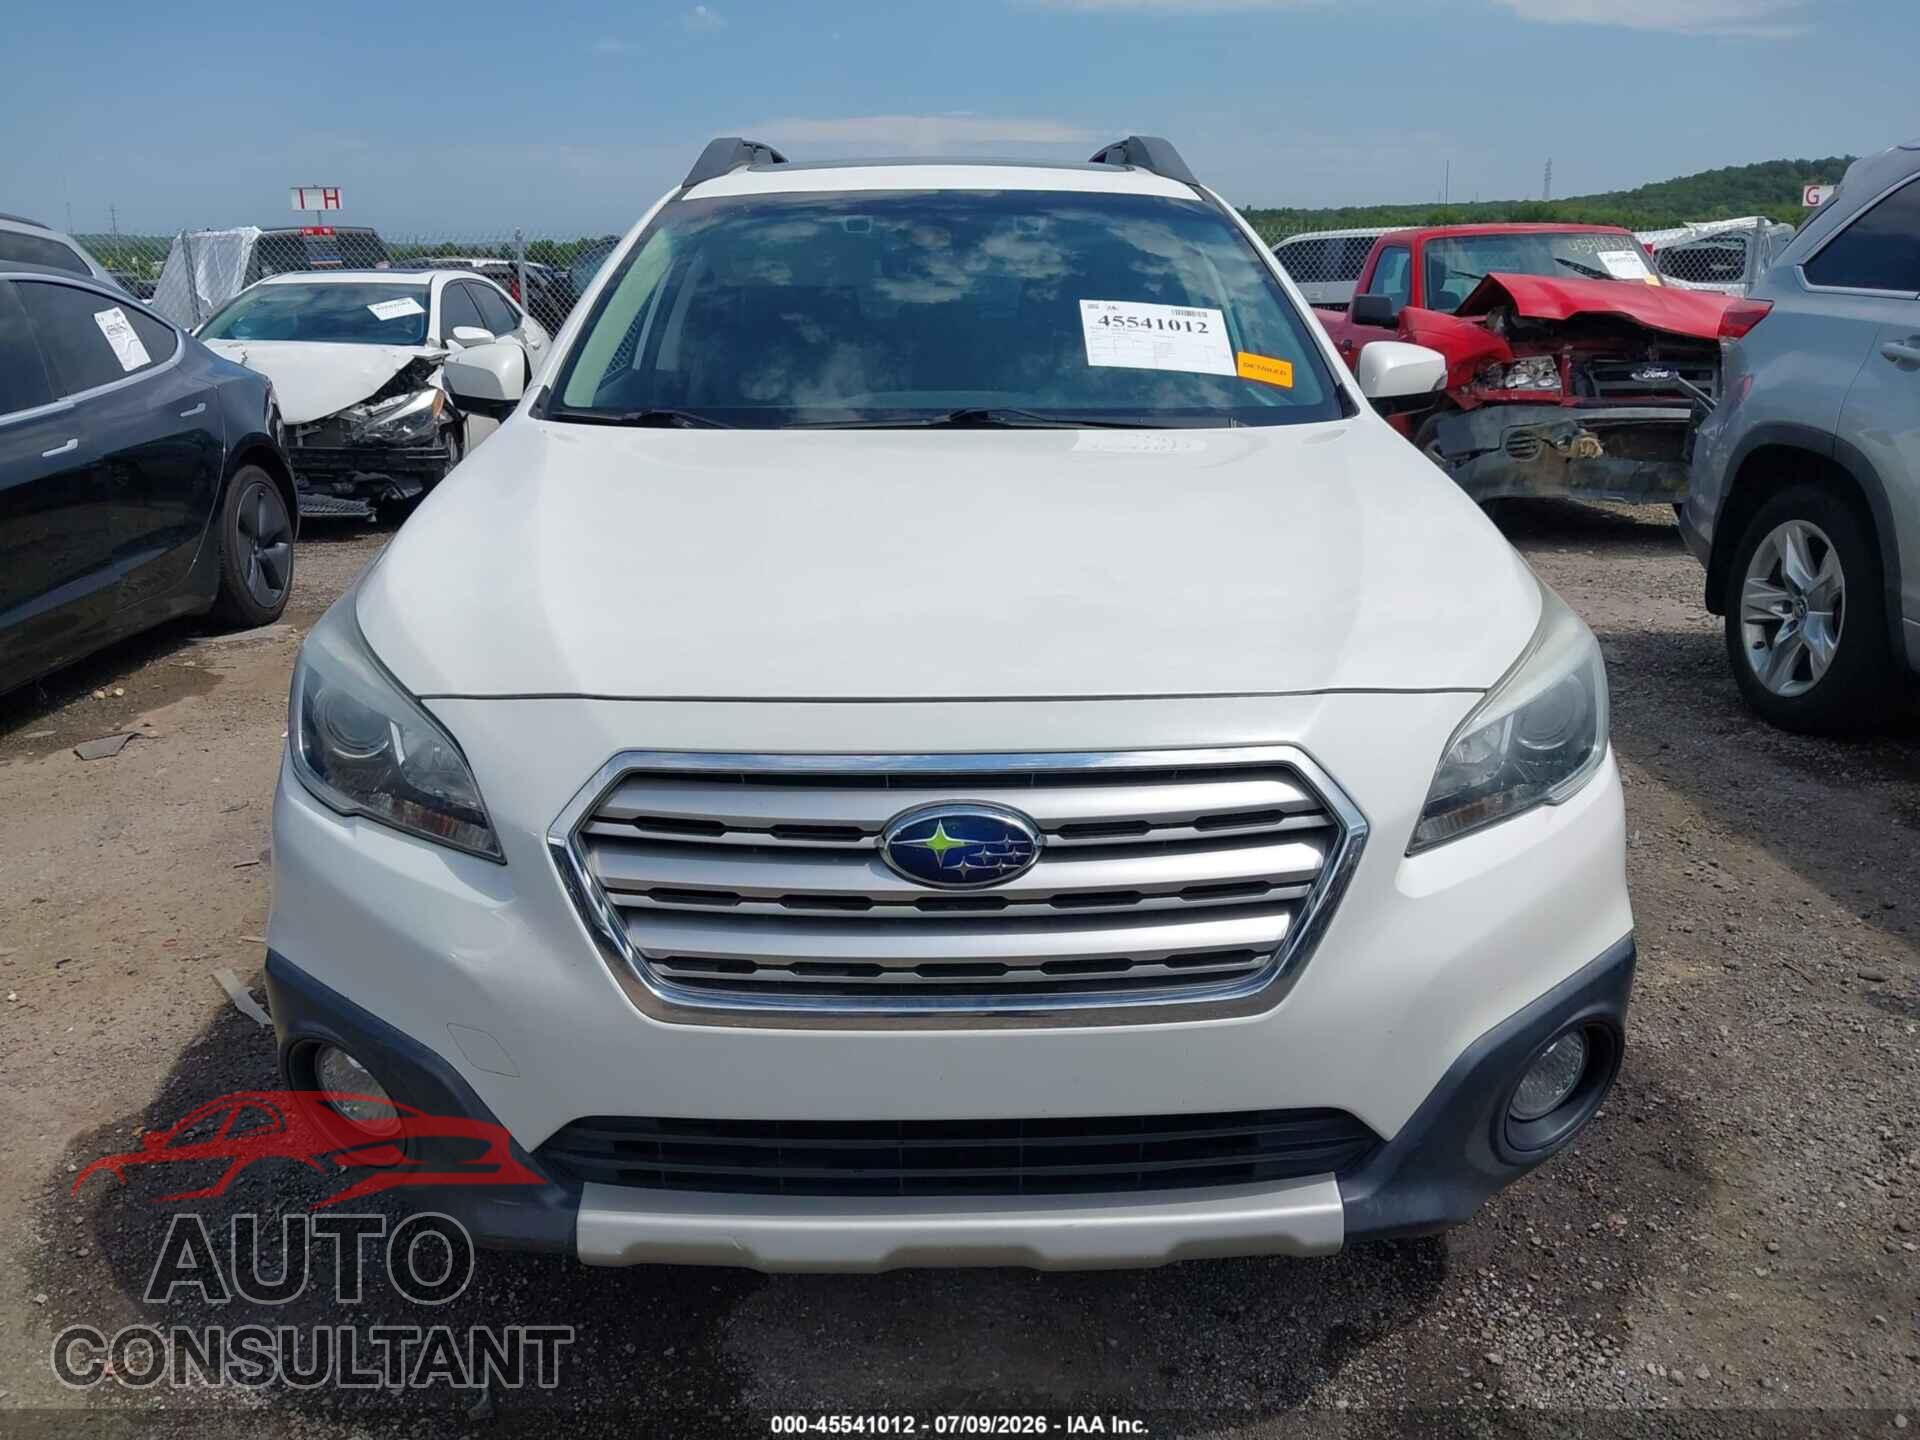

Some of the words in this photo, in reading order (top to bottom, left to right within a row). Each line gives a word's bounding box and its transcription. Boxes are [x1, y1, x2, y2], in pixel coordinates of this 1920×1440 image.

[322, 188, 340, 209] H
[1805, 186, 1820, 205] G
[1098, 315, 1209, 334] 45541012
[1642, 366, 1669, 378] Ford
